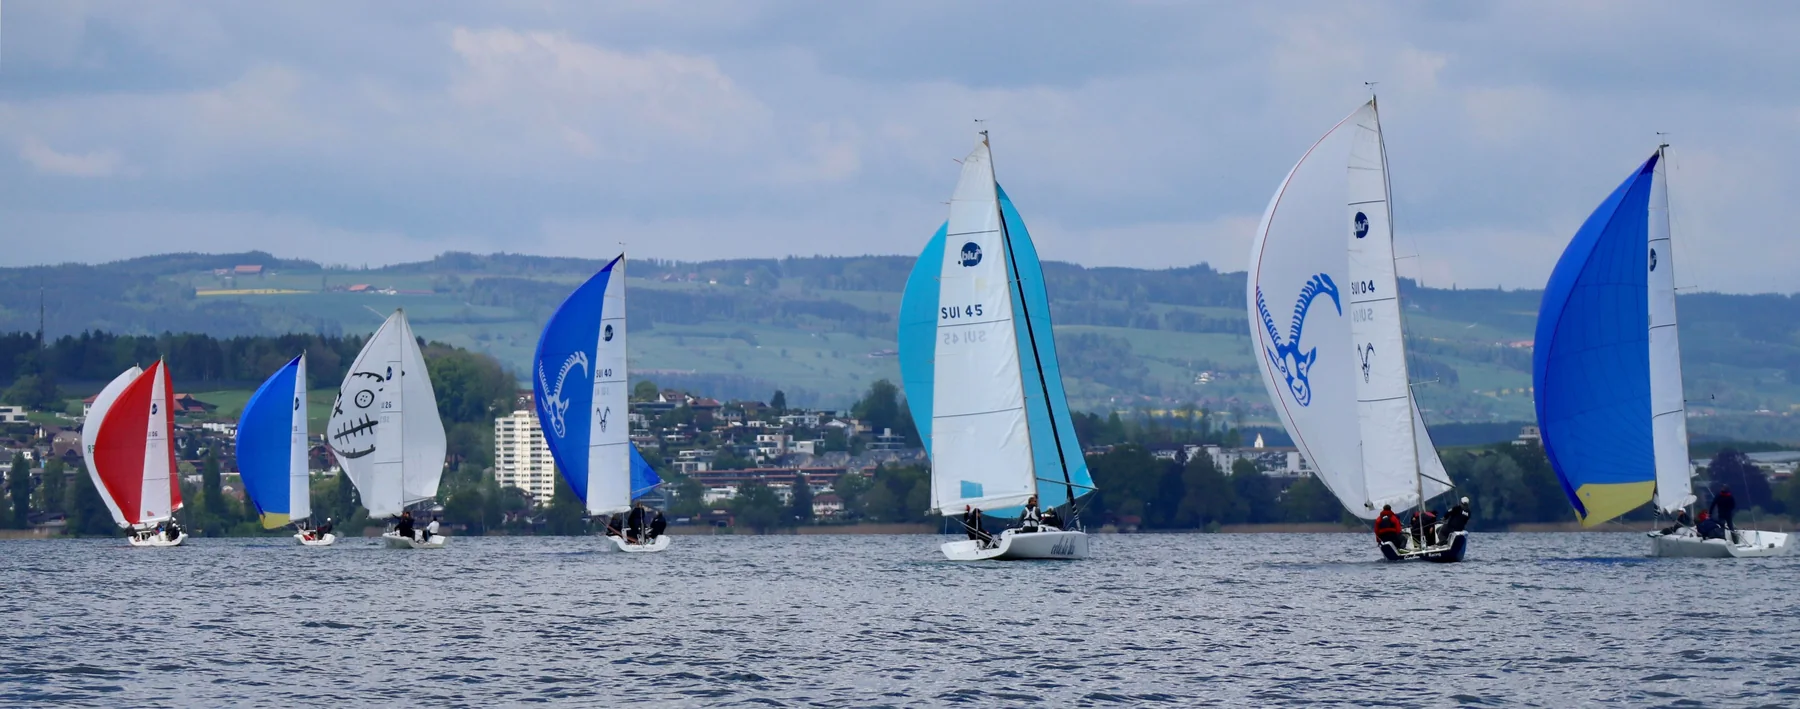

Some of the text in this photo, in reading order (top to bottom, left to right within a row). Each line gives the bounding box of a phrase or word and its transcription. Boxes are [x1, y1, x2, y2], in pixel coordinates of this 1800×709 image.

[1361, 279, 1375, 294] 04
[941, 304, 983, 319] SUI 45
